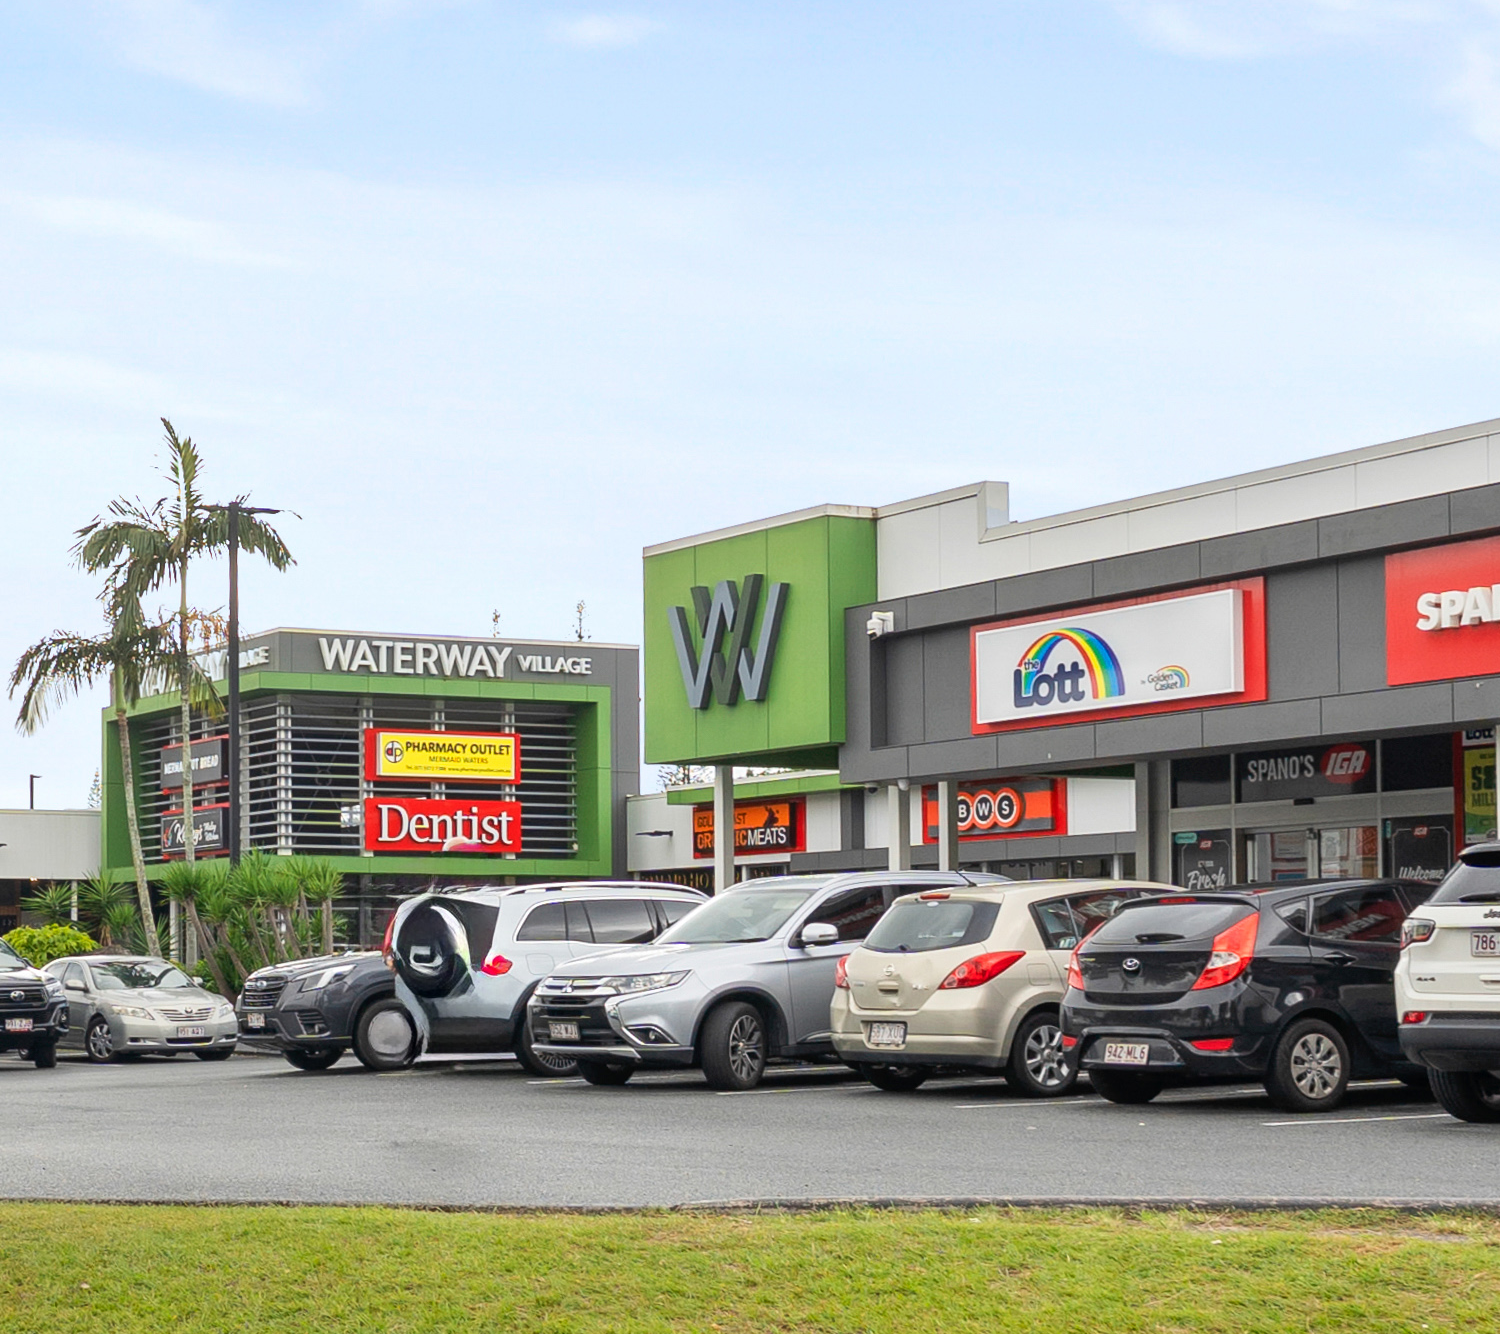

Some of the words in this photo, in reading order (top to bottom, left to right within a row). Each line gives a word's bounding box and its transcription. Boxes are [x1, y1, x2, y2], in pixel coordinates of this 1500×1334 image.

[319, 637, 513, 678] WATERWAY
[517, 654, 592, 675] VILLAGE
[1024, 659, 1040, 671] the
[1014, 661, 1085, 708] Lott
[1148, 672, 1175, 683] Golden
[1155, 681, 1179, 692] Casket
[405, 741, 468, 754] PHARMACY
[470, 743, 511, 756] OUTLET
[1248, 755, 1315, 782] SPANO'S
[1326, 750, 1367, 776] IGA
[958, 800, 1010, 820] BWS
[377, 804, 514, 844] Dentist
[747, 827, 786, 846] MEATS
[1399, 866, 1445, 880] Welcome
